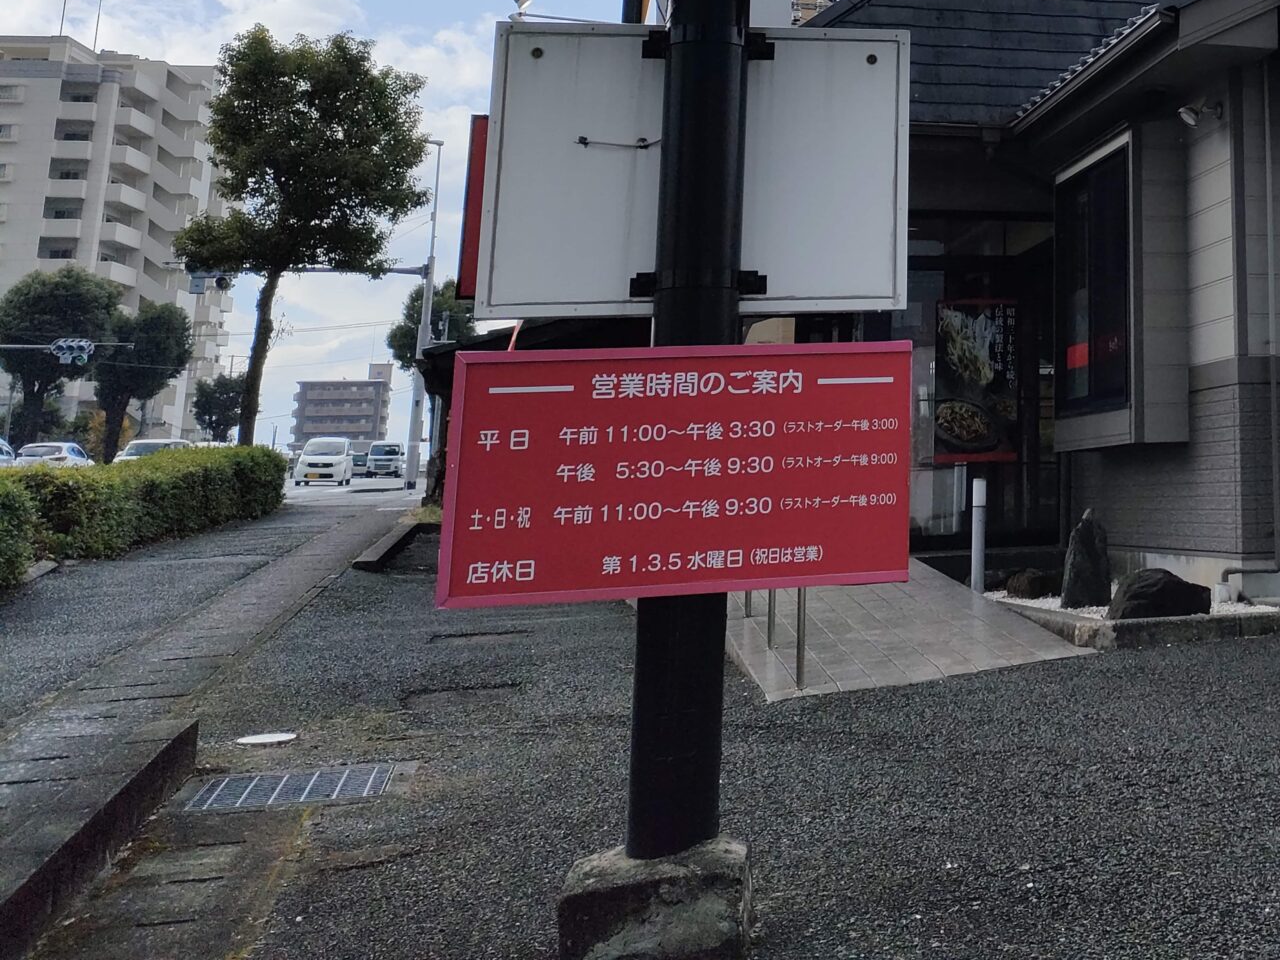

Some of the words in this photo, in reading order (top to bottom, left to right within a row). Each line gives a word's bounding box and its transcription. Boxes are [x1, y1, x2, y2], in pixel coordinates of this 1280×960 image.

[592, 369, 803, 399] 営業時間のご案内
[556, 464, 596, 483] 午後
[467, 559, 535, 584] 店休日
